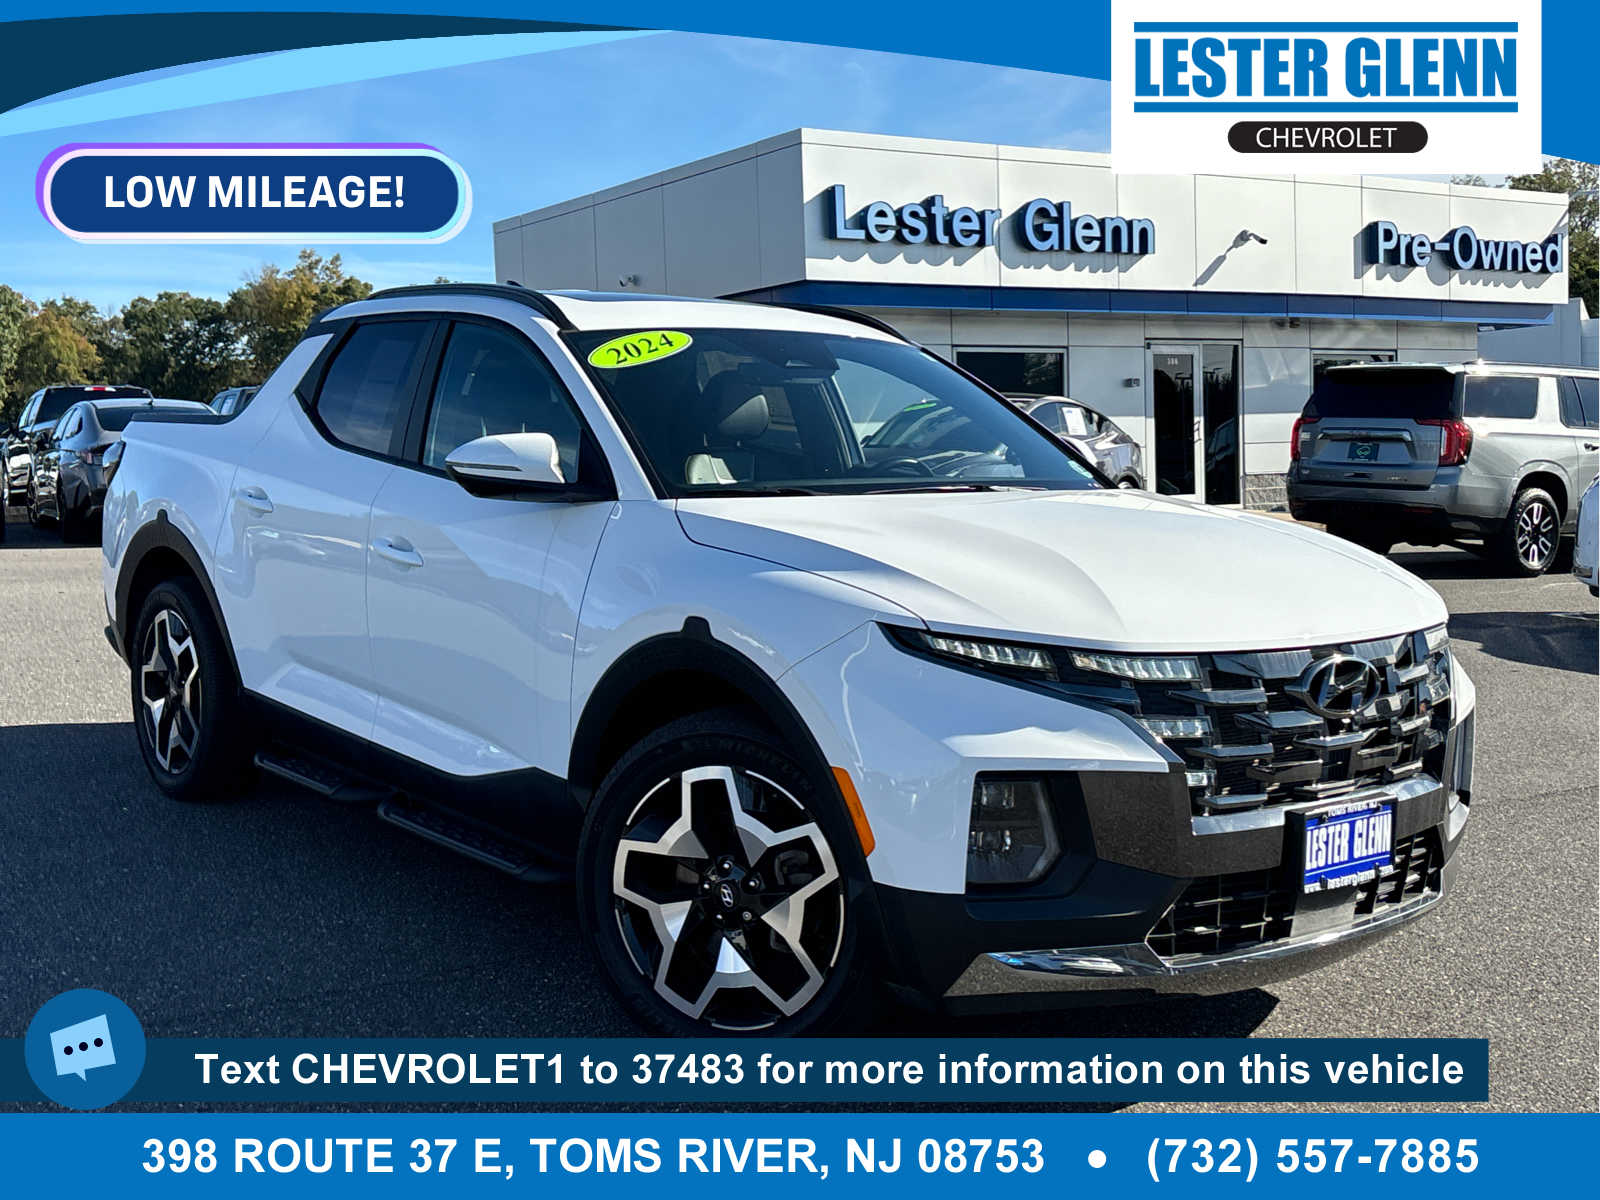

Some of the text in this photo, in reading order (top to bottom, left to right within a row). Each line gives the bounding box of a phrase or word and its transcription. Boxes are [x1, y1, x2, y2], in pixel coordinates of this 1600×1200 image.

[828, 184, 1155, 254] Lester Glenn
[1374, 220, 1564, 274] Pre-Owned
[606, 333, 674, 365] 2024
[1305, 813, 1392, 871] LESTER GLENN
